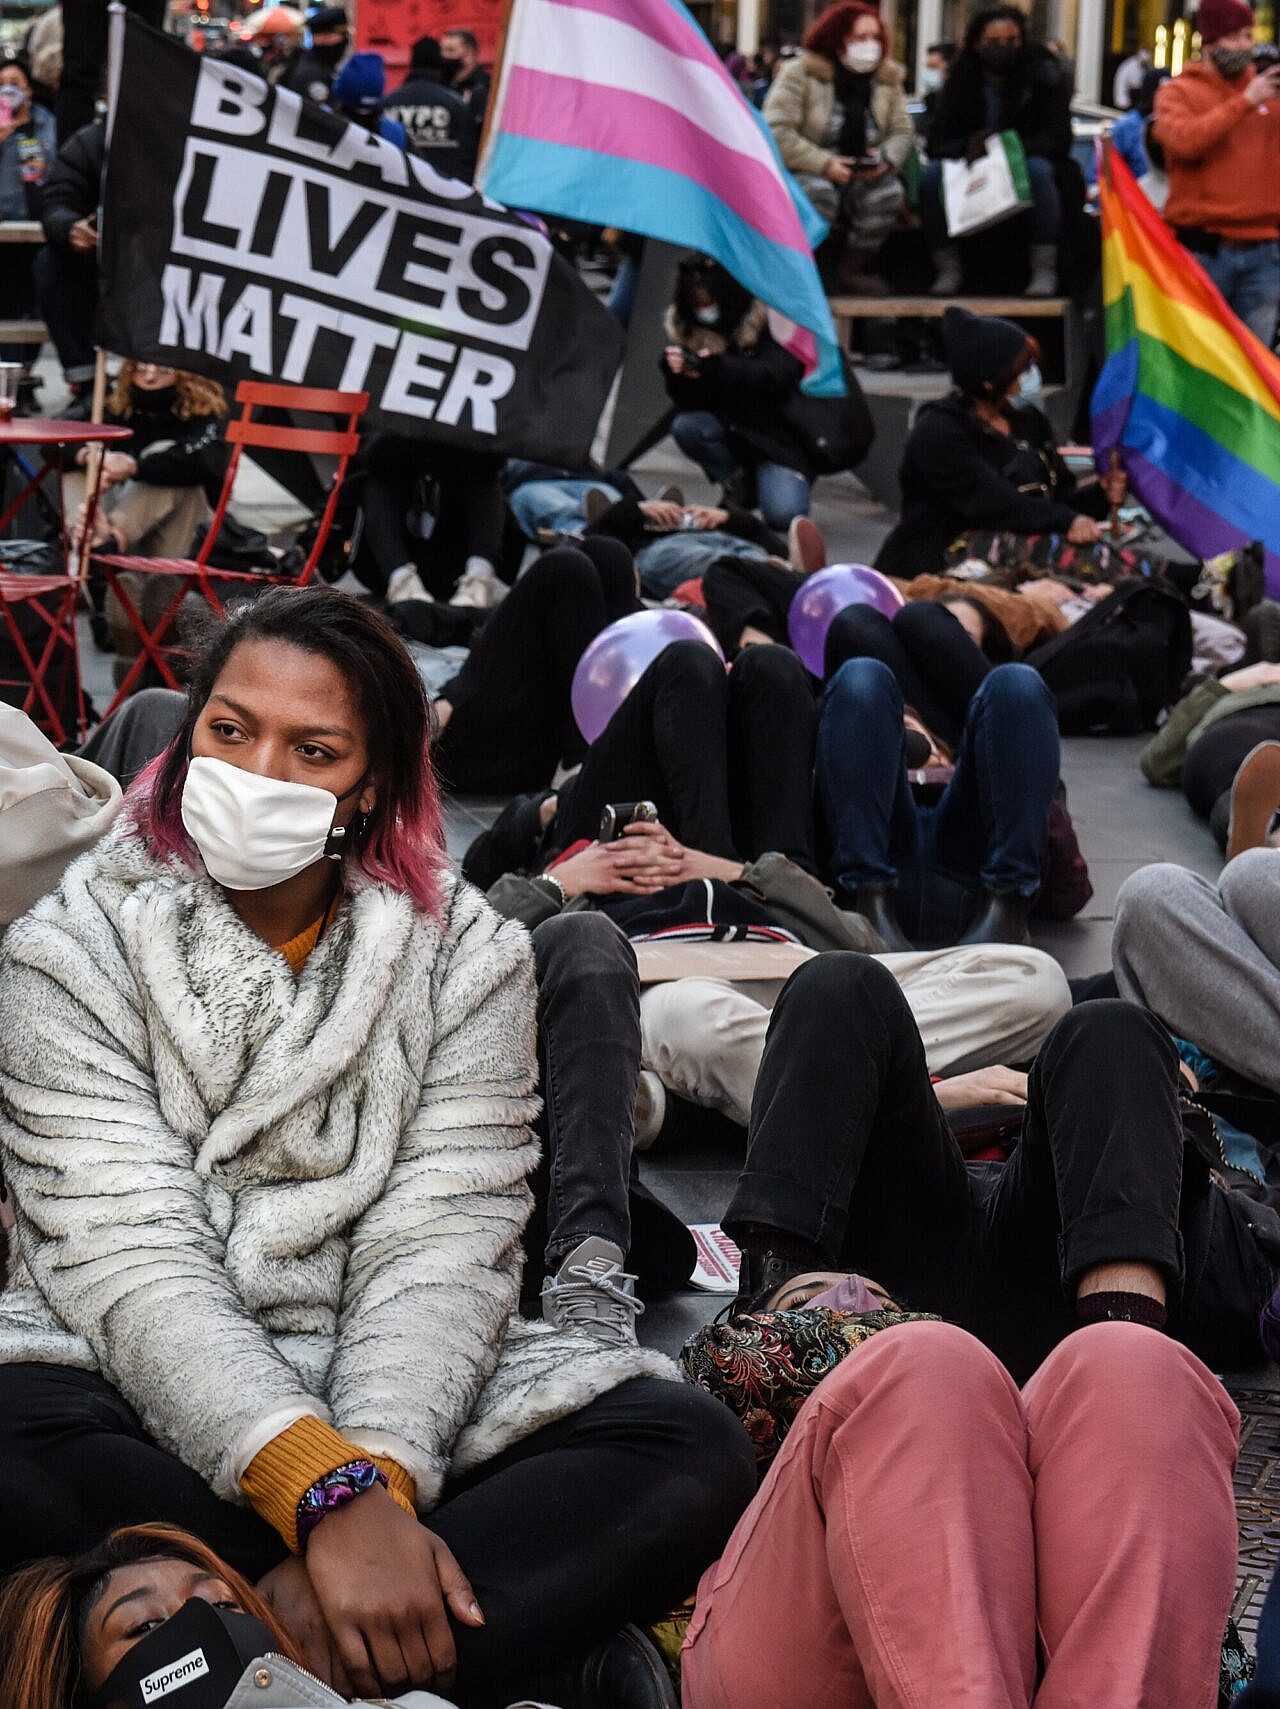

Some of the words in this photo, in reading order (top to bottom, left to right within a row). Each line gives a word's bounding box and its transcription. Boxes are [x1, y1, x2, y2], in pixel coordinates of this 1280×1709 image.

[190, 56, 507, 214] BLA
[182, 151, 536, 327] LIVES
[158, 264, 516, 436] MATTER
[143, 1656, 203, 1695] Supreme
